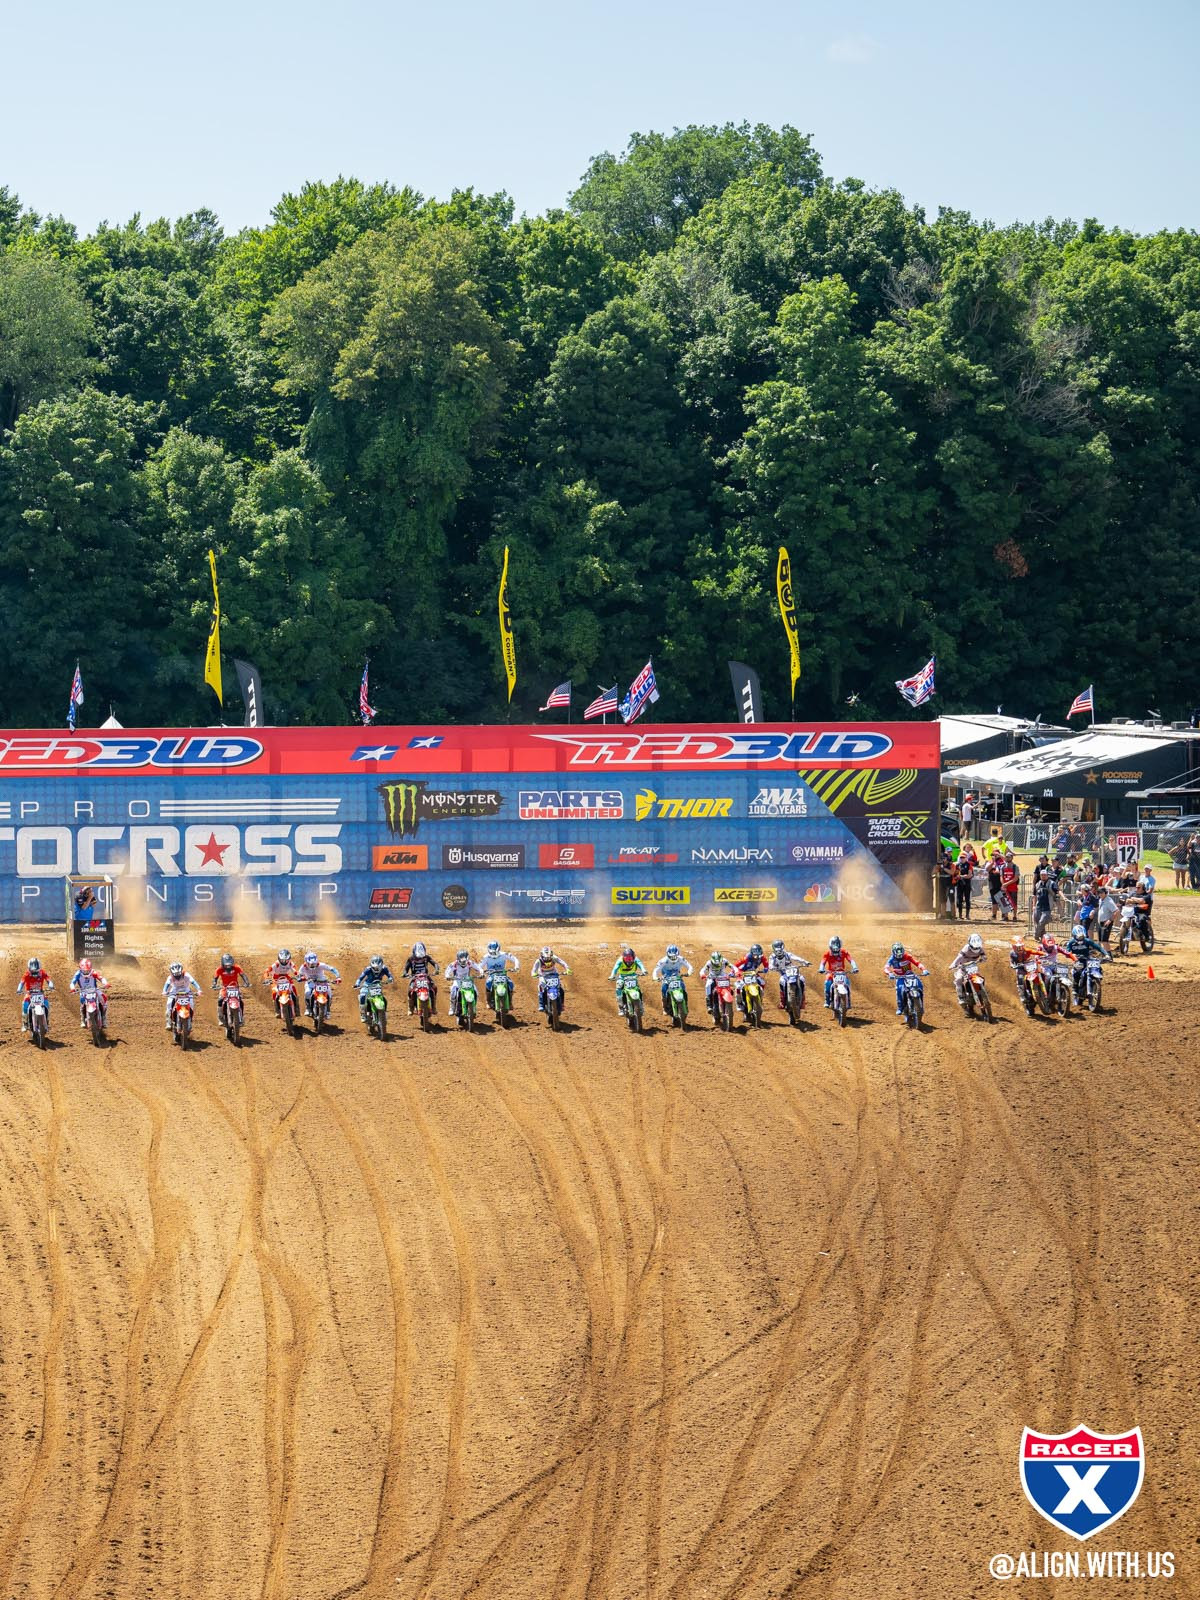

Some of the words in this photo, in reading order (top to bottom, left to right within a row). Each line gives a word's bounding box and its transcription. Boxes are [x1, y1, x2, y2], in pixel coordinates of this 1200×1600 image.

[1102, 771, 1143, 779] ROCKSTAR
[422, 792, 499, 808] MONSTER
[519, 791, 623, 808] PARTS
[751, 788, 805, 804] AMA
[20, 801, 150, 819] PRO
[520, 807, 623, 819] UNLIMITED
[657, 798, 734, 818] THOR
[749, 805, 766, 814] 100
[779, 804, 808, 814] YEARS
[898, 816, 929, 839] X
[1118, 836, 1137, 846] GATE
[383, 851, 419, 864] KTM
[462, 851, 520, 864] Husqvarna
[691, 846, 773, 860] NAMURA
[803, 847, 844, 857] YAMAHA
[1118, 846, 1137, 864] 12
[372, 889, 413, 904] ETS
[495, 889, 586, 897] INTENSE
[615, 889, 685, 901] SUZUKI
[716, 890, 776, 900] ACERBIS
[837, 884, 875, 901] NBC
